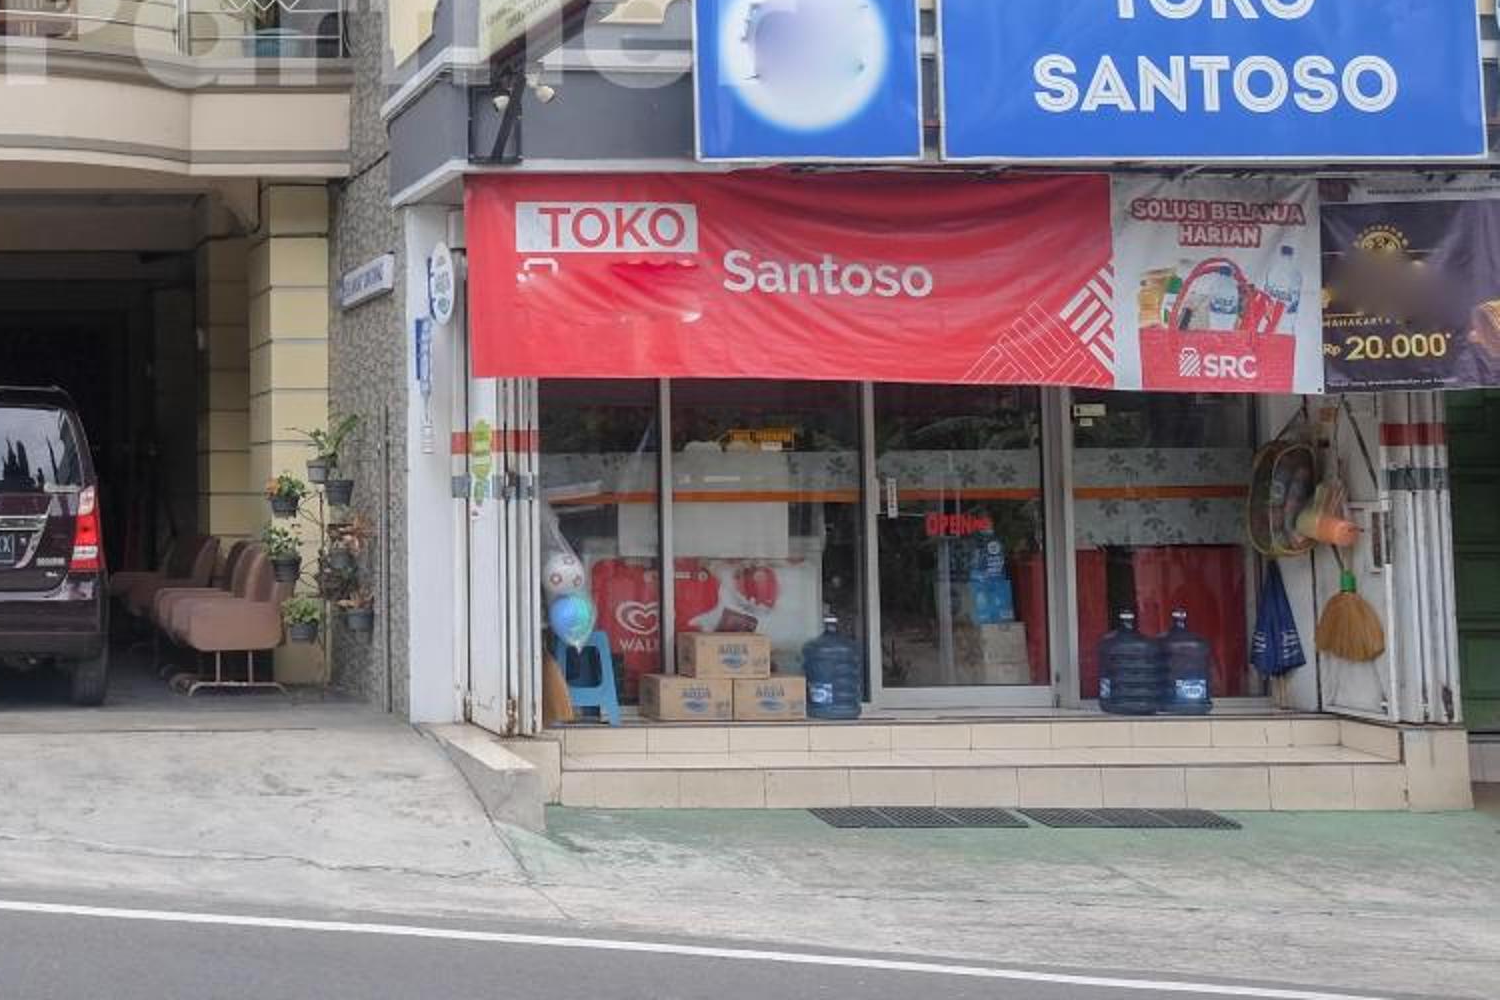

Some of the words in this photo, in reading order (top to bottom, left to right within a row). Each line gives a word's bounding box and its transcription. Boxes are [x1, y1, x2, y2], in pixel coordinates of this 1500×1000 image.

[1033, 54, 1398, 112] SANTOSO
[538, 207, 685, 248] TOKO
[1132, 199, 1205, 219] SOLUSI
[1211, 202, 1306, 224] BELANJA
[1179, 226, 1259, 246] HARIAN
[722, 249, 934, 297] Santoso
[1203, 354, 1257, 378] SRC
